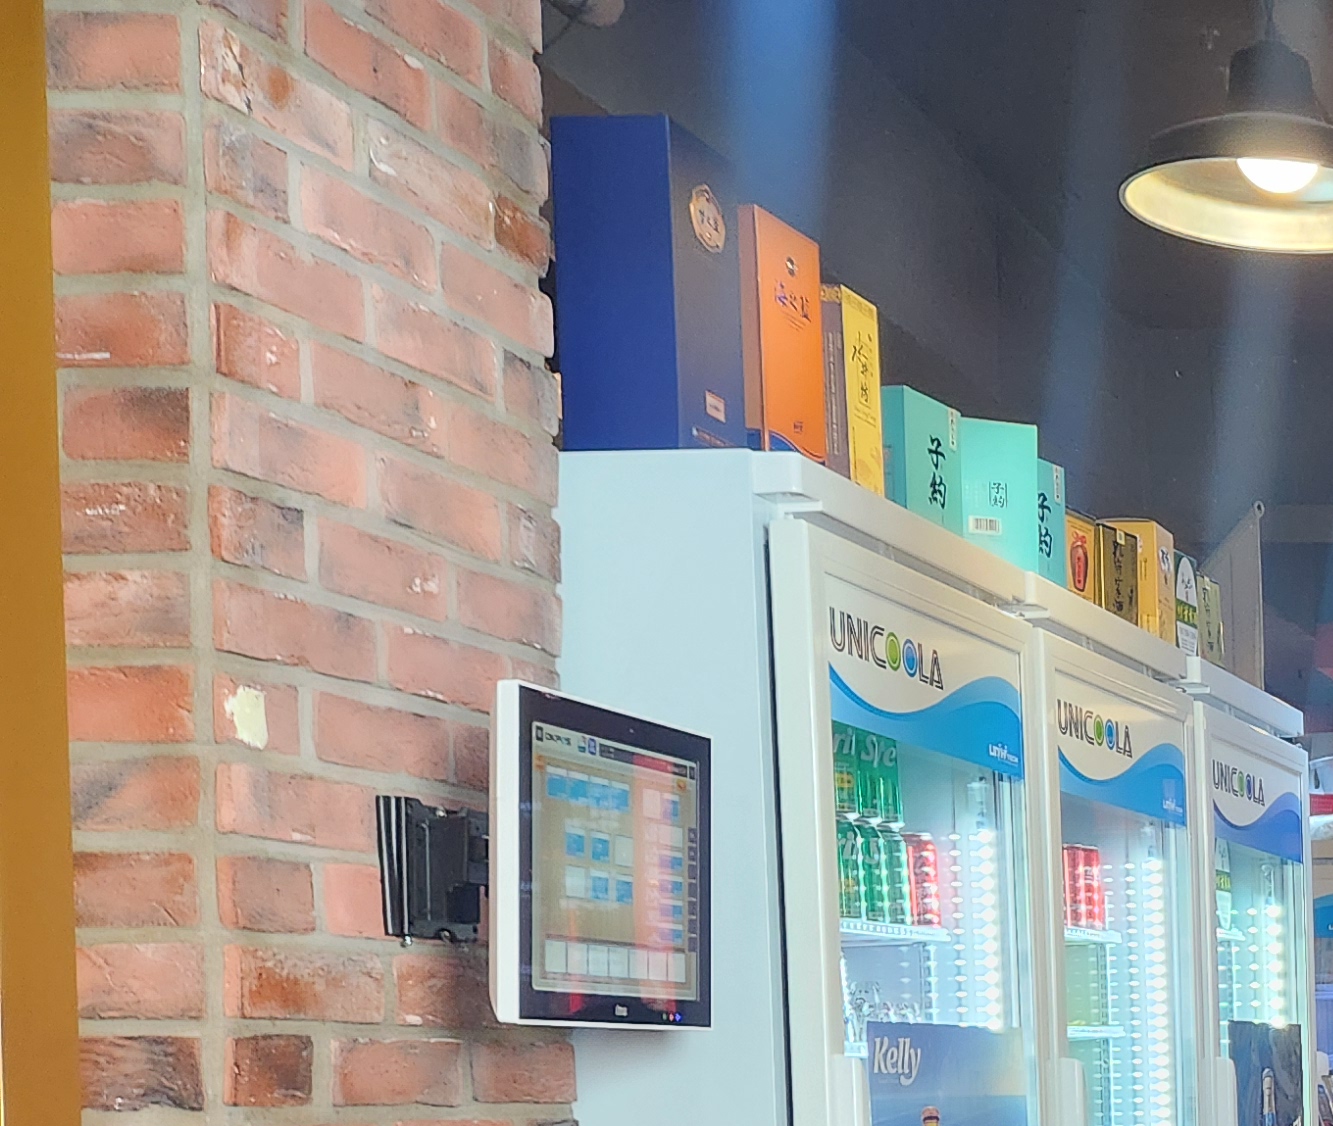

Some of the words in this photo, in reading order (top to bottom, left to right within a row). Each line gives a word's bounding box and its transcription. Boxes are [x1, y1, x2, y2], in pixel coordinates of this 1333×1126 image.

[829, 606, 944, 690] UNICOOLA
[1057, 698, 1133, 759] UNICOOLA
[1212, 759, 1266, 807] UNICOOLA
[873, 1036, 922, 1086] Kelly
